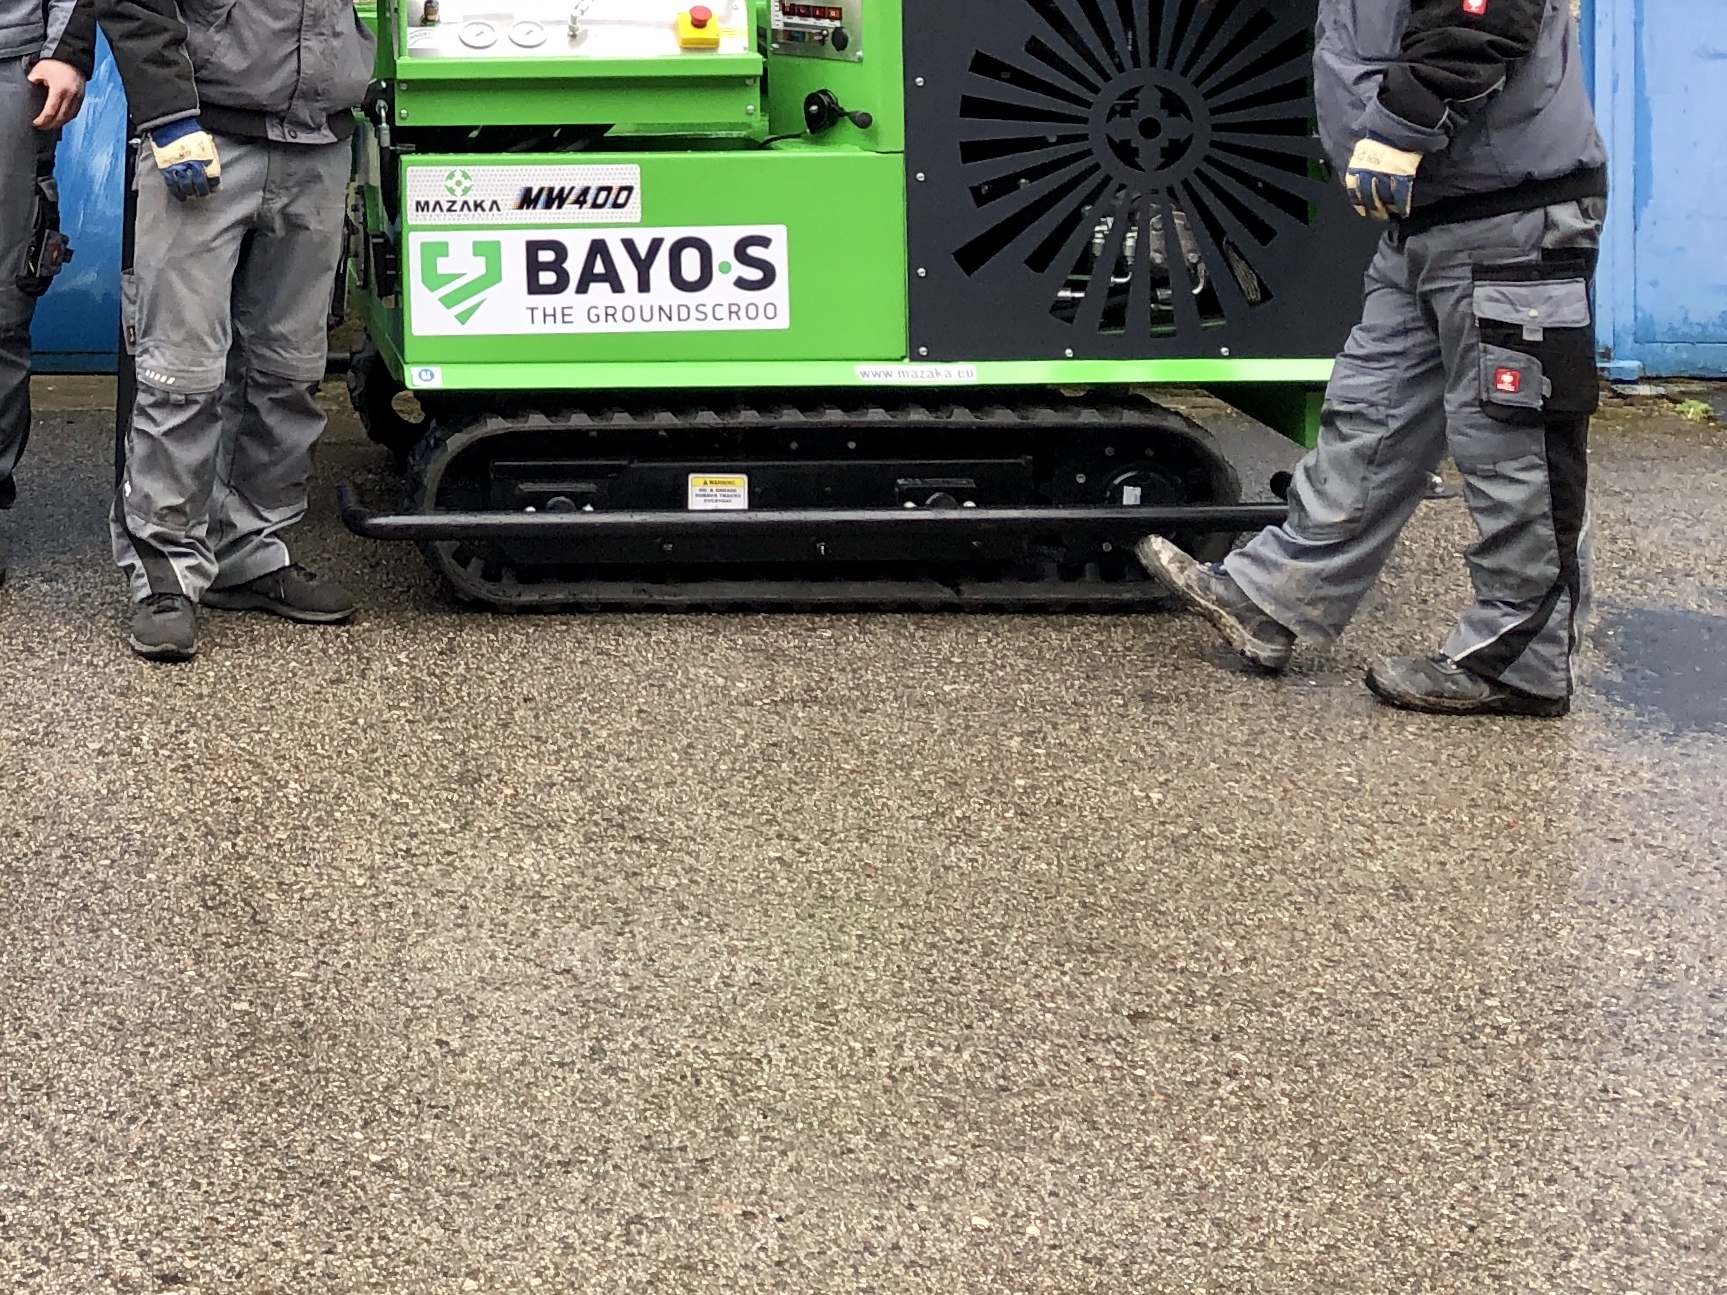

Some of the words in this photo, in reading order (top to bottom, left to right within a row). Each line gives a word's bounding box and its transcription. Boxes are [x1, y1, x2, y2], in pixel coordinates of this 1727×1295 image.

[415, 199, 502, 213] MAZAKA
[514, 185, 635, 210] MW400
[526, 306, 574, 325] THE
[586, 302, 778, 324] GROUNDSCROO
[859, 367, 975, 379] wwwmazakaeu
